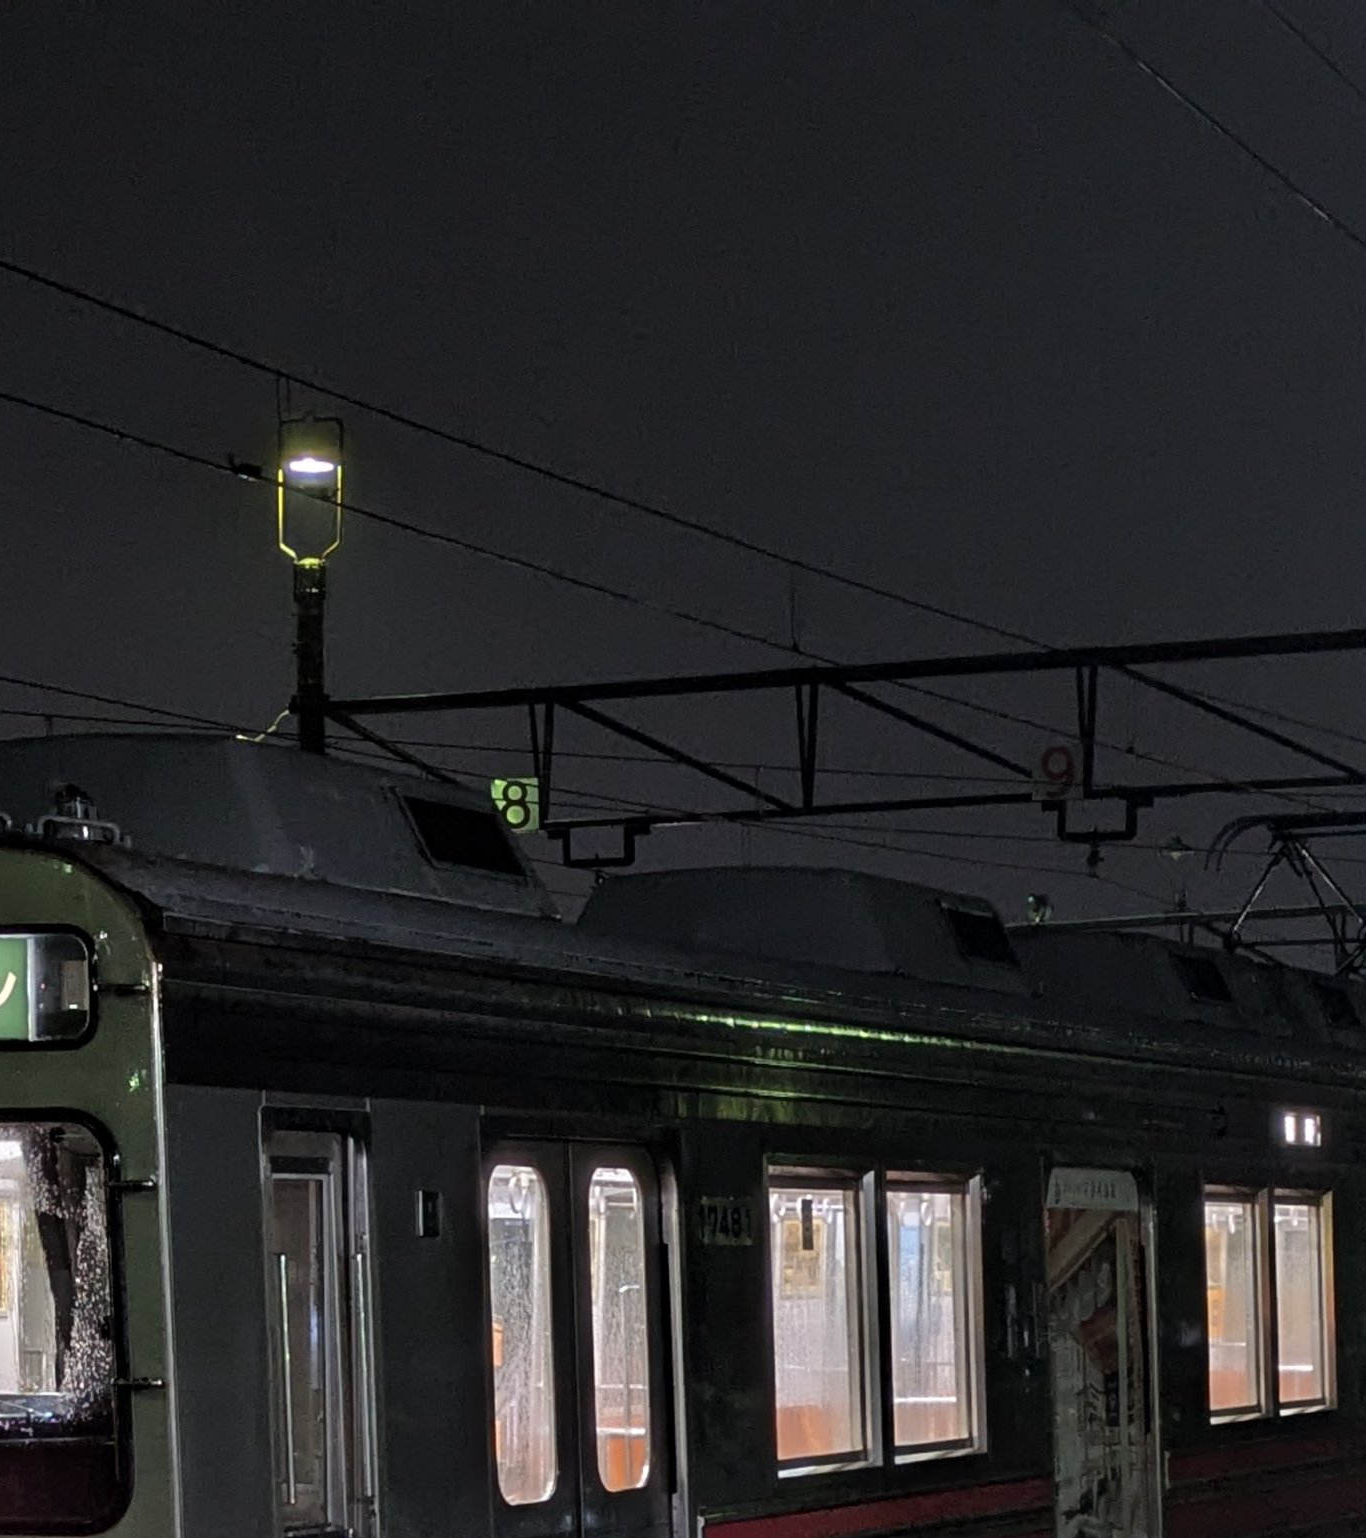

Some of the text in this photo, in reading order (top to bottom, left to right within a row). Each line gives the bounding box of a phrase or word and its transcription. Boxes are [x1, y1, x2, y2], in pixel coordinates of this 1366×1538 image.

[1041, 745, 1075, 798] 9
[501, 780, 531, 829] 8
[698, 1204, 752, 1241] 17481
